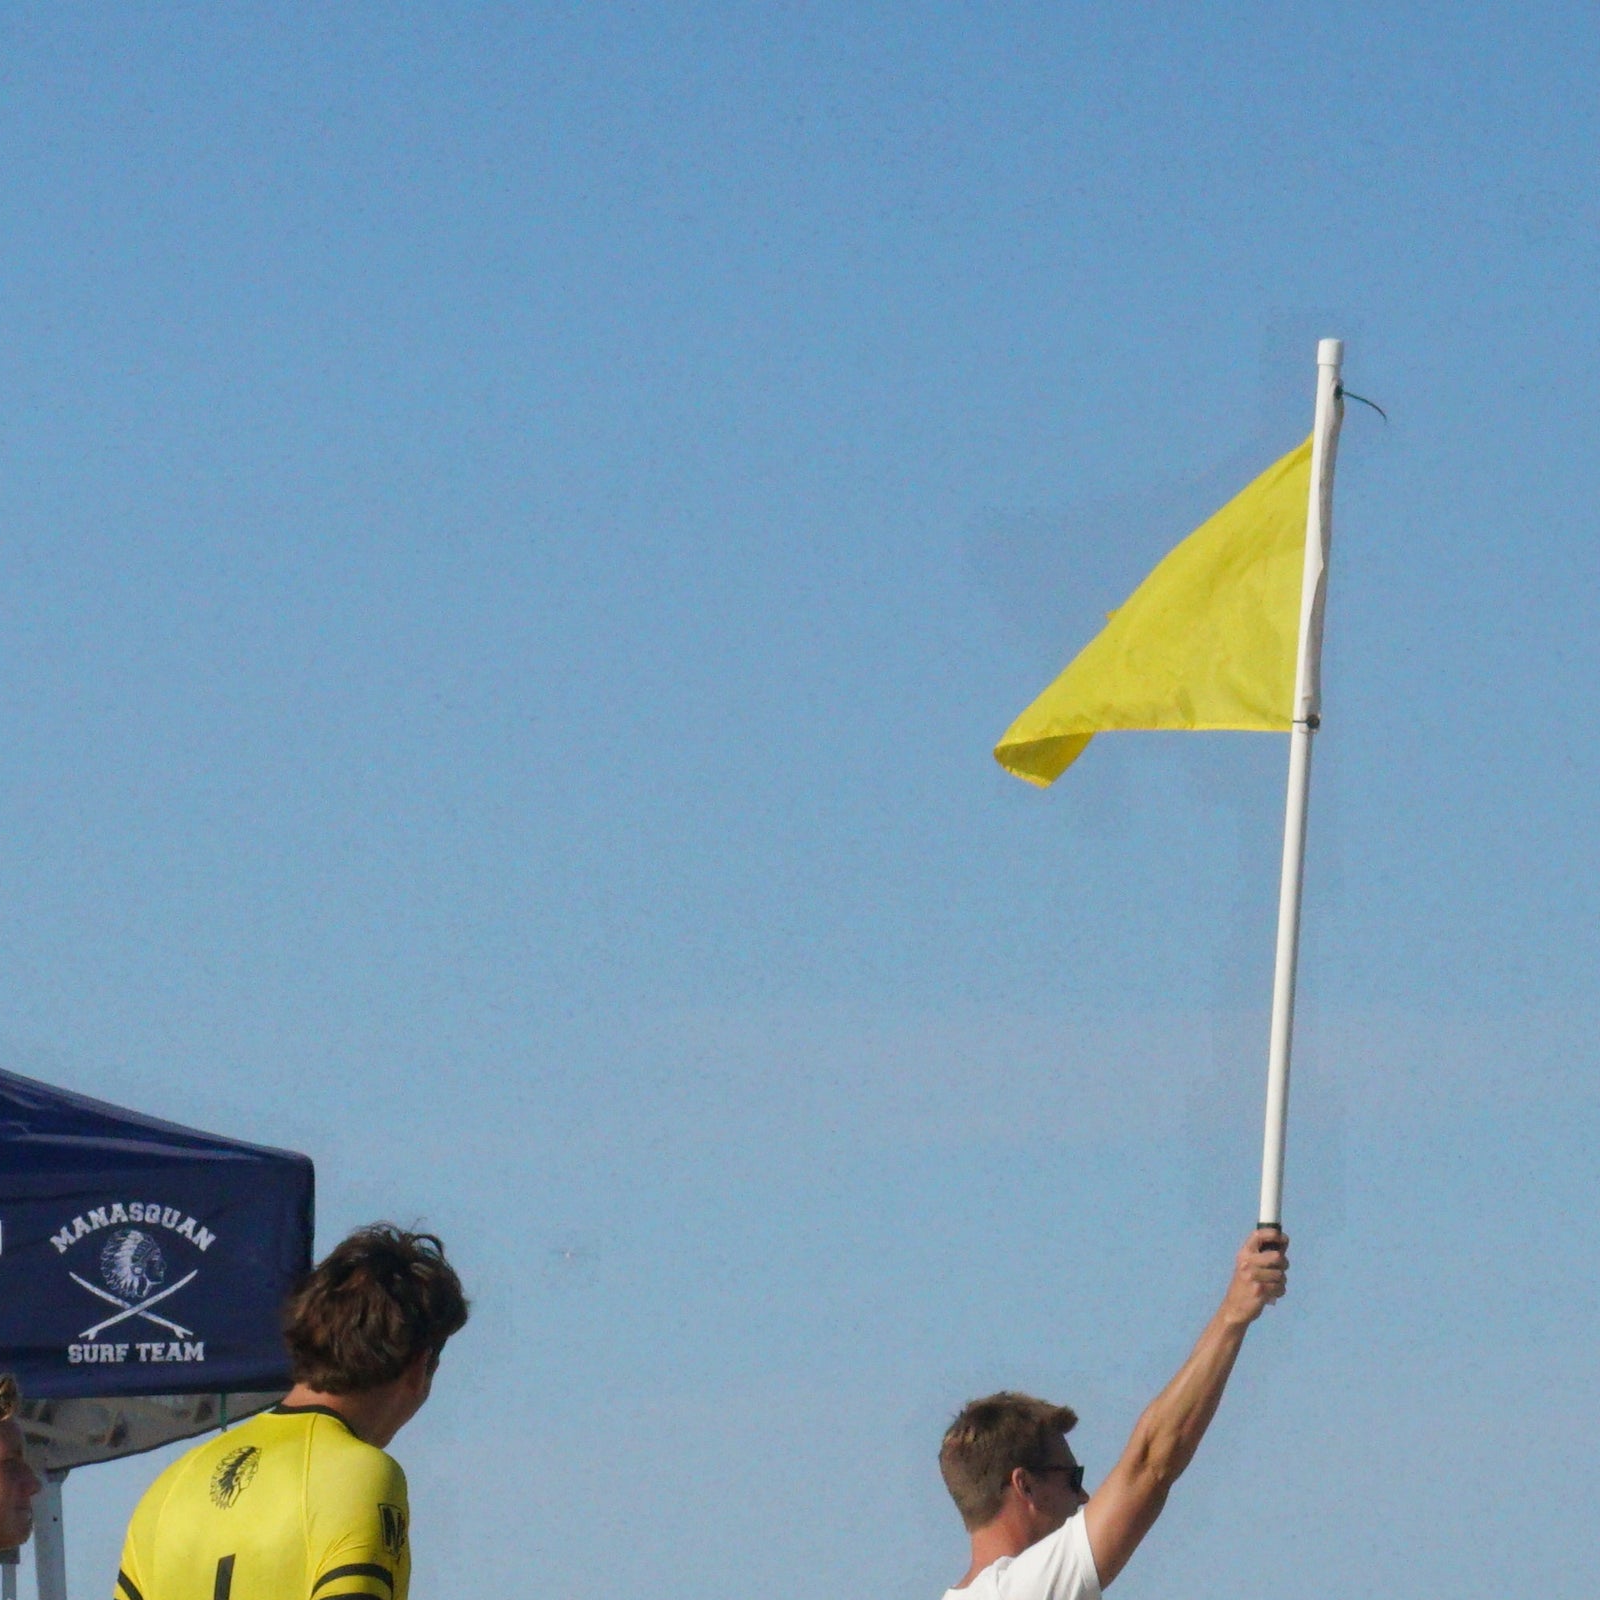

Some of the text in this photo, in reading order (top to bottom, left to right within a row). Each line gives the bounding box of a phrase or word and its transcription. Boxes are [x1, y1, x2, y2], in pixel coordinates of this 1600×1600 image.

[50, 1202, 217, 1254] MANASQUAN
[68, 1342, 205, 1363] SURF TEAM
